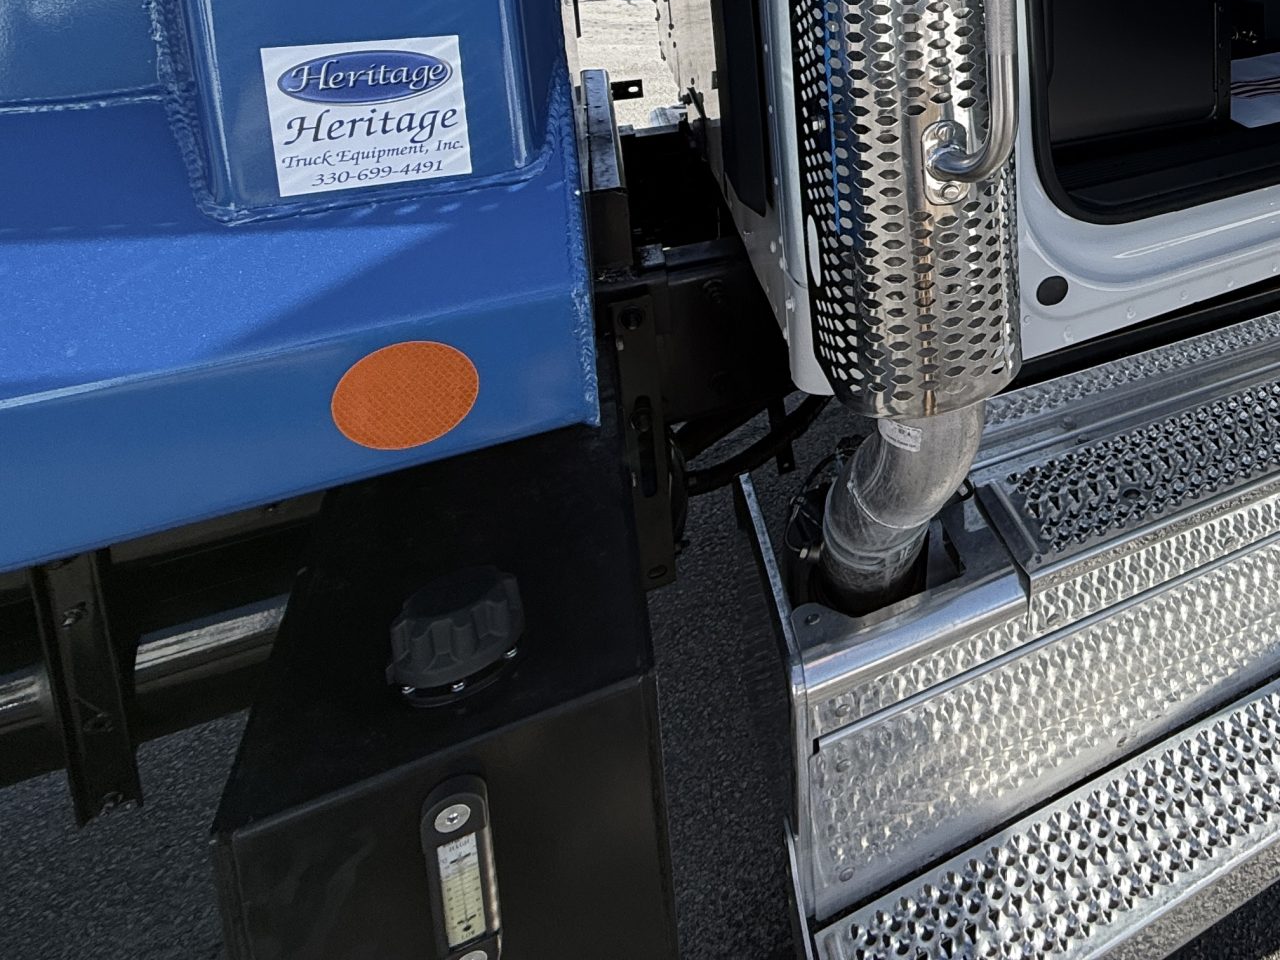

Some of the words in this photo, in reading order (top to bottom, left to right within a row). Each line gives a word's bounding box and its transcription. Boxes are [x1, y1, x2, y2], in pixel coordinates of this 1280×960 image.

[287, 60, 443, 92] Heritage
[283, 108, 458, 145] Heritage
[282, 151, 335, 169] Truck
[336, 143, 429, 166] Equipment,
[436, 139, 464, 152] Inc.
[312, 159, 444, 187] 330-699-4491
